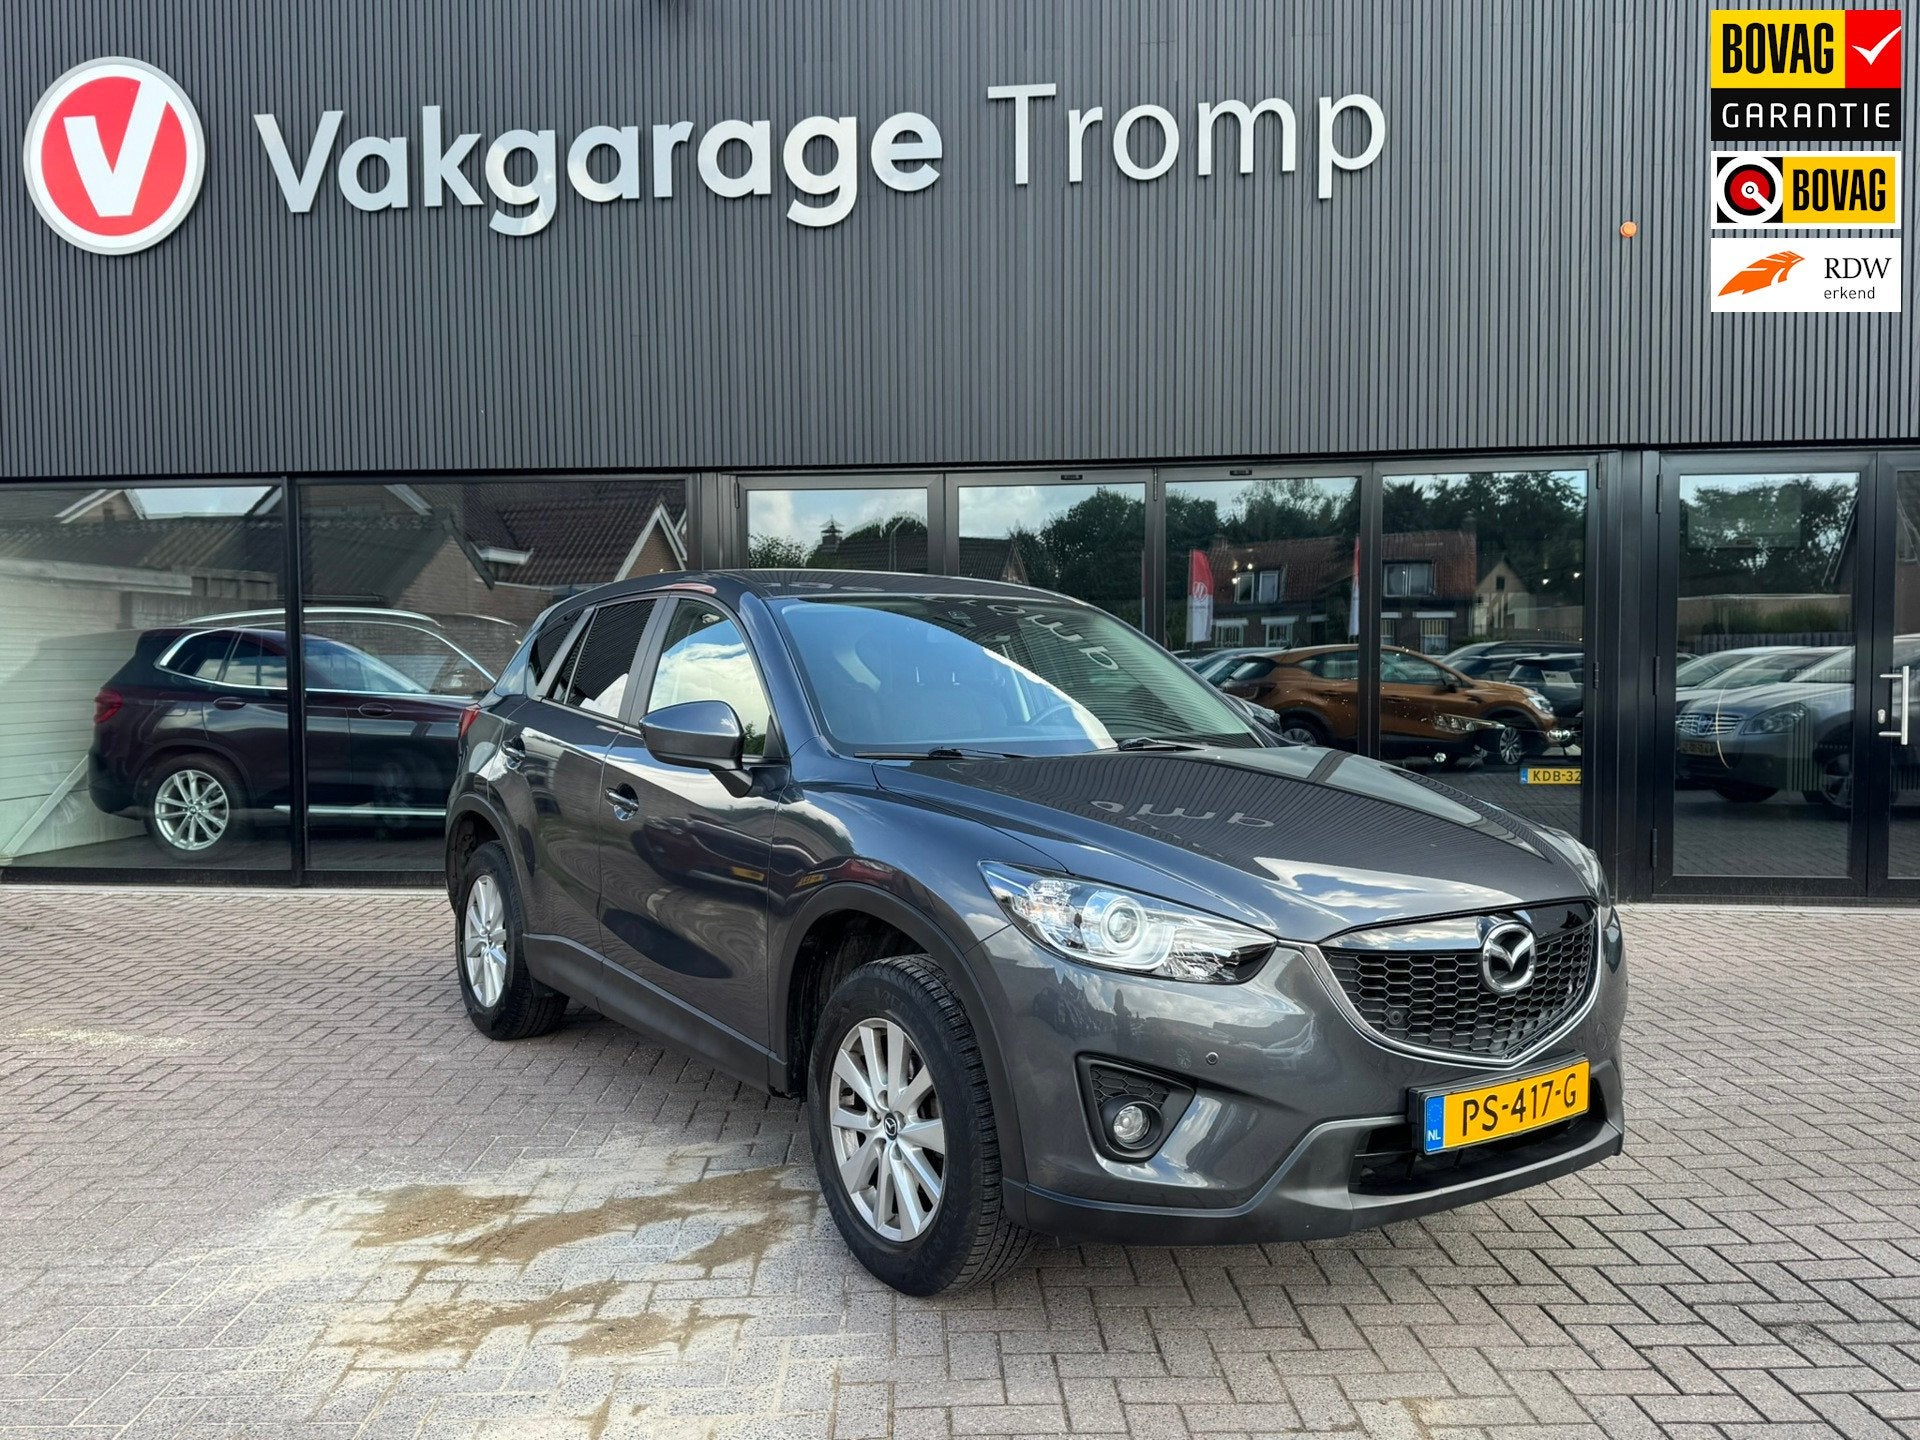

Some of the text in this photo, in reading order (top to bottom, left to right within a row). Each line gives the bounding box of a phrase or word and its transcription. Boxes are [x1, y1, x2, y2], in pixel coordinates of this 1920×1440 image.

[253, 83, 1387, 236] Vakgarage Tromp
[1428, 1129, 1441, 1141] NL
[1462, 1073, 1577, 1137] PS-417-G
